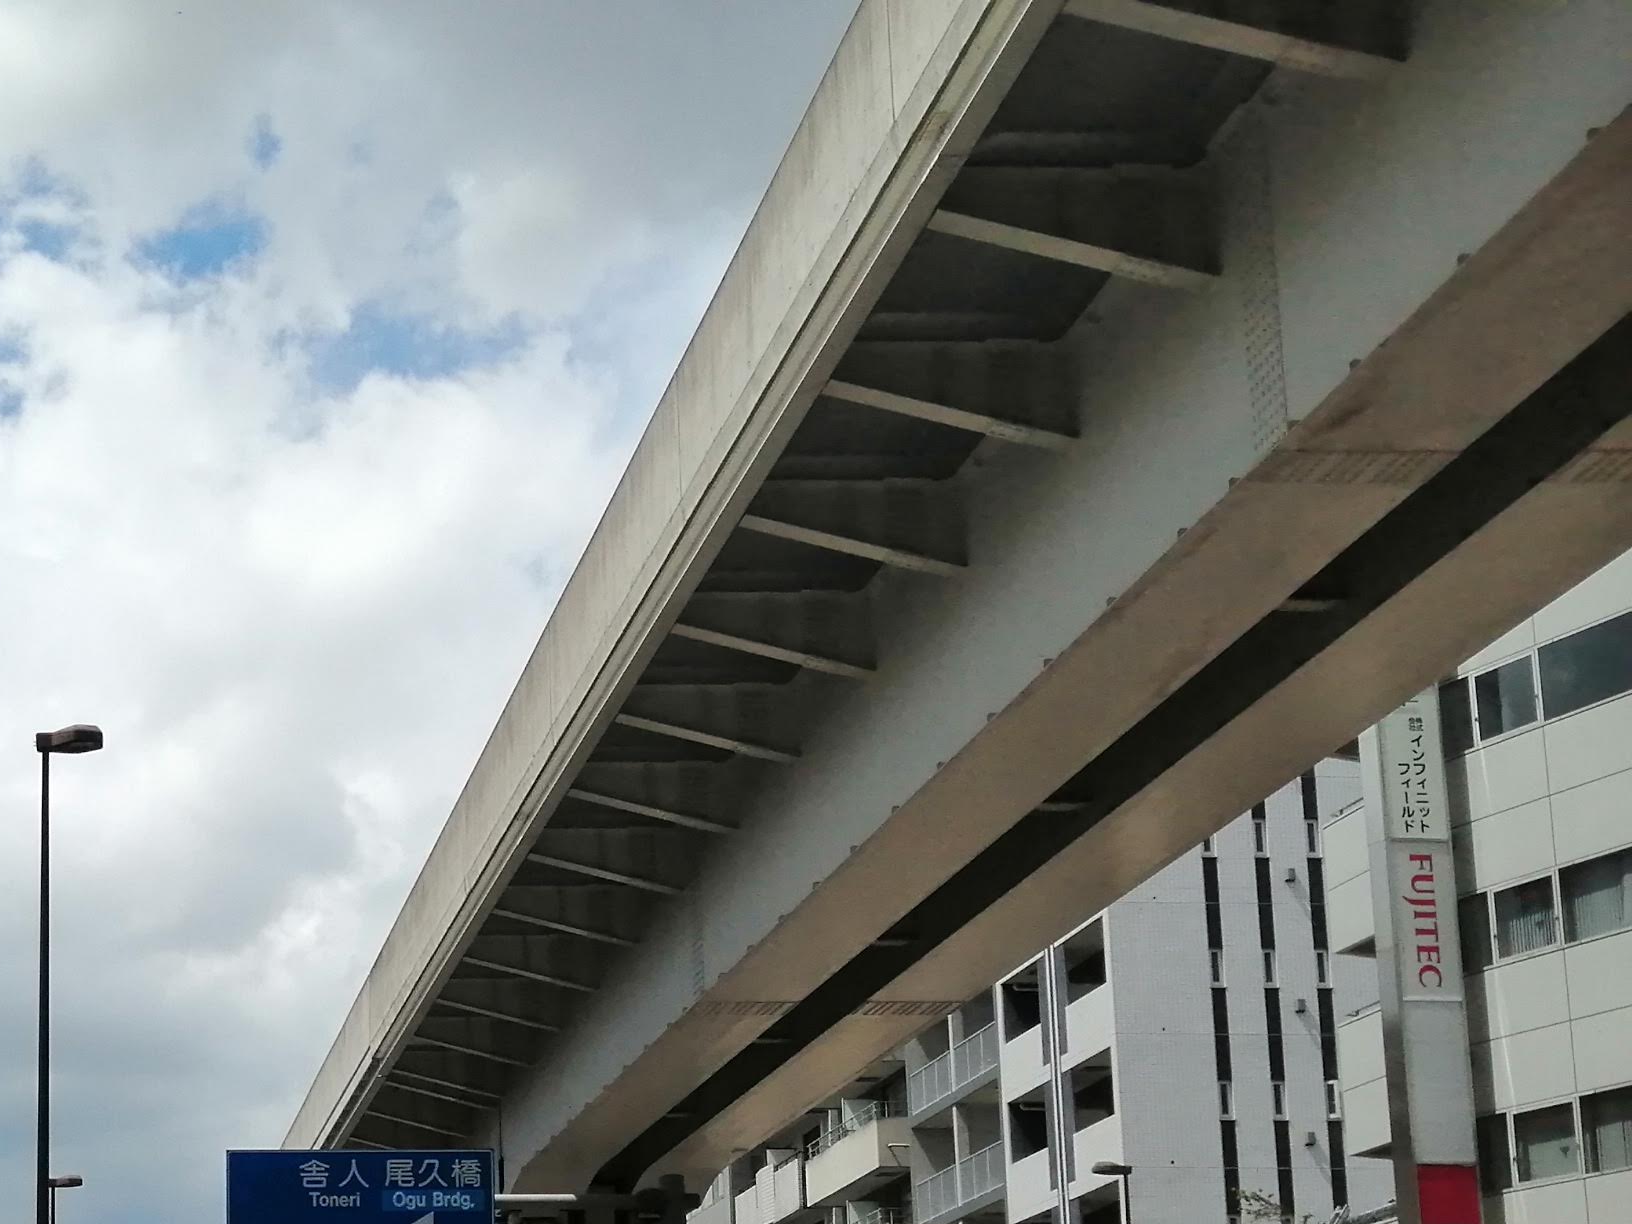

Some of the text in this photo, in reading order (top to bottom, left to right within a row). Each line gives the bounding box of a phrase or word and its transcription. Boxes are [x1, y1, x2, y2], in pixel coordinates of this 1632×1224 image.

[1397, 763, 1416, 834] フィールド
[1402, 853, 1442, 988] FUJITEC
[299, 1159, 483, 1188] 舎人 尾久橋
[308, 1192, 475, 1210] Toneri Ogu Brdg.
